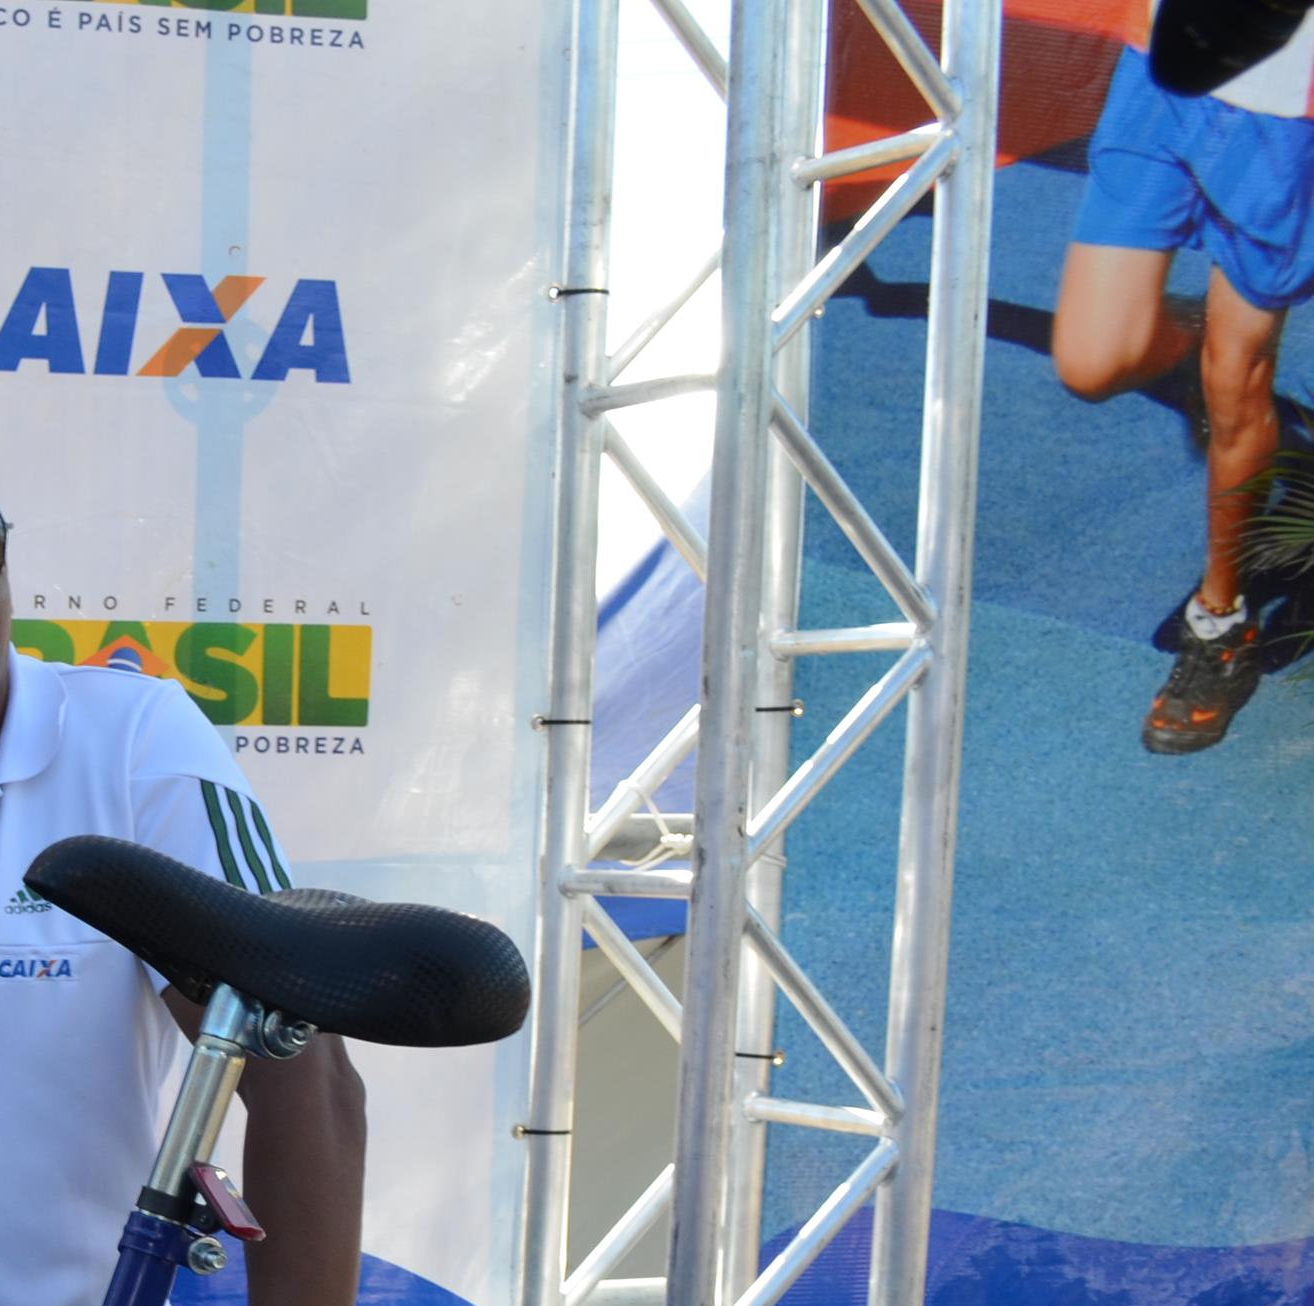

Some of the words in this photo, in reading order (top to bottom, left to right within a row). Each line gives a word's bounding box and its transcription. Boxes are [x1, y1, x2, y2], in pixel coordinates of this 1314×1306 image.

[48, 8, 62, 30] É
[78, 10, 142, 33] PAÍS
[157, 18, 213, 39] SEM
[227, 24, 365, 49] POBREZA
[165, 597, 370, 615] FEDERAL
[11, 618, 373, 727] SIL
[235, 736, 365, 755] POBREZA
